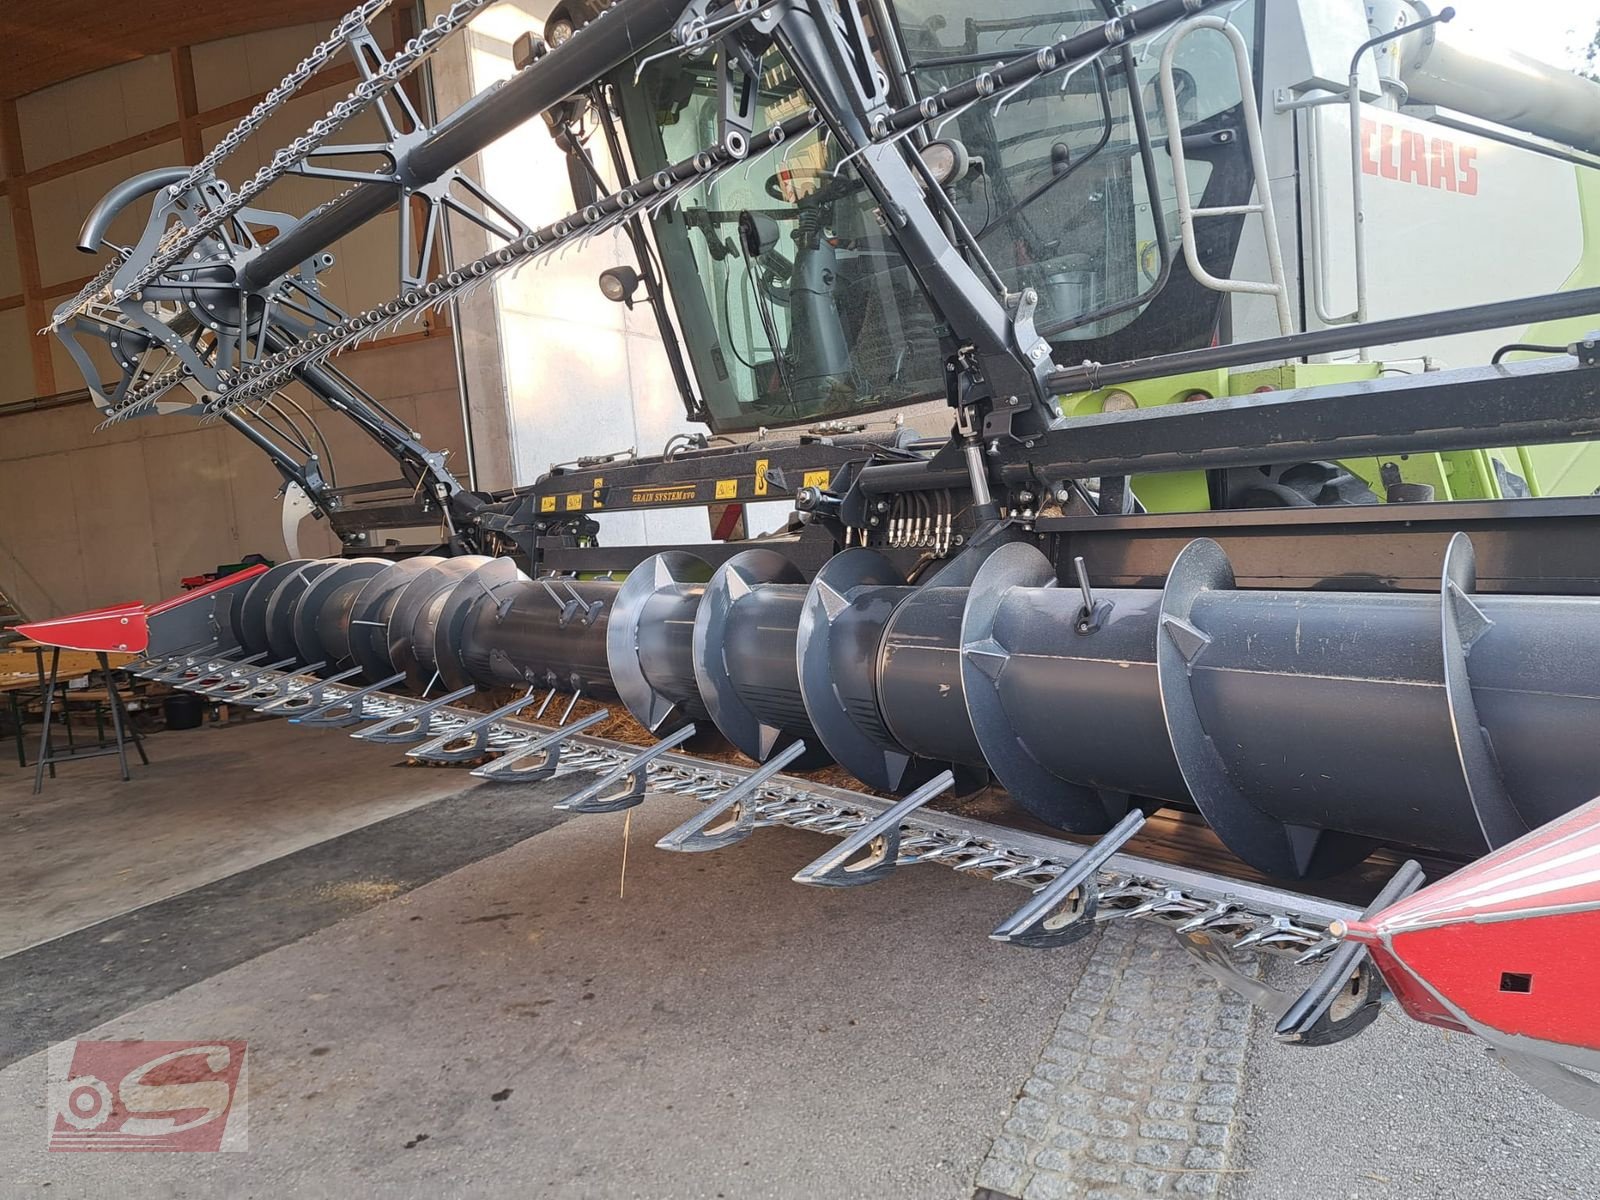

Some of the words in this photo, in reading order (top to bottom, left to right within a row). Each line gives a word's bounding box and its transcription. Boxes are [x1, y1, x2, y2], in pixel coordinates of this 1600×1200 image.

[1360, 117, 1478, 196] CLAAS
[632, 494, 654, 503] GRAIN
[654, 492, 683, 502] SYSTEM
